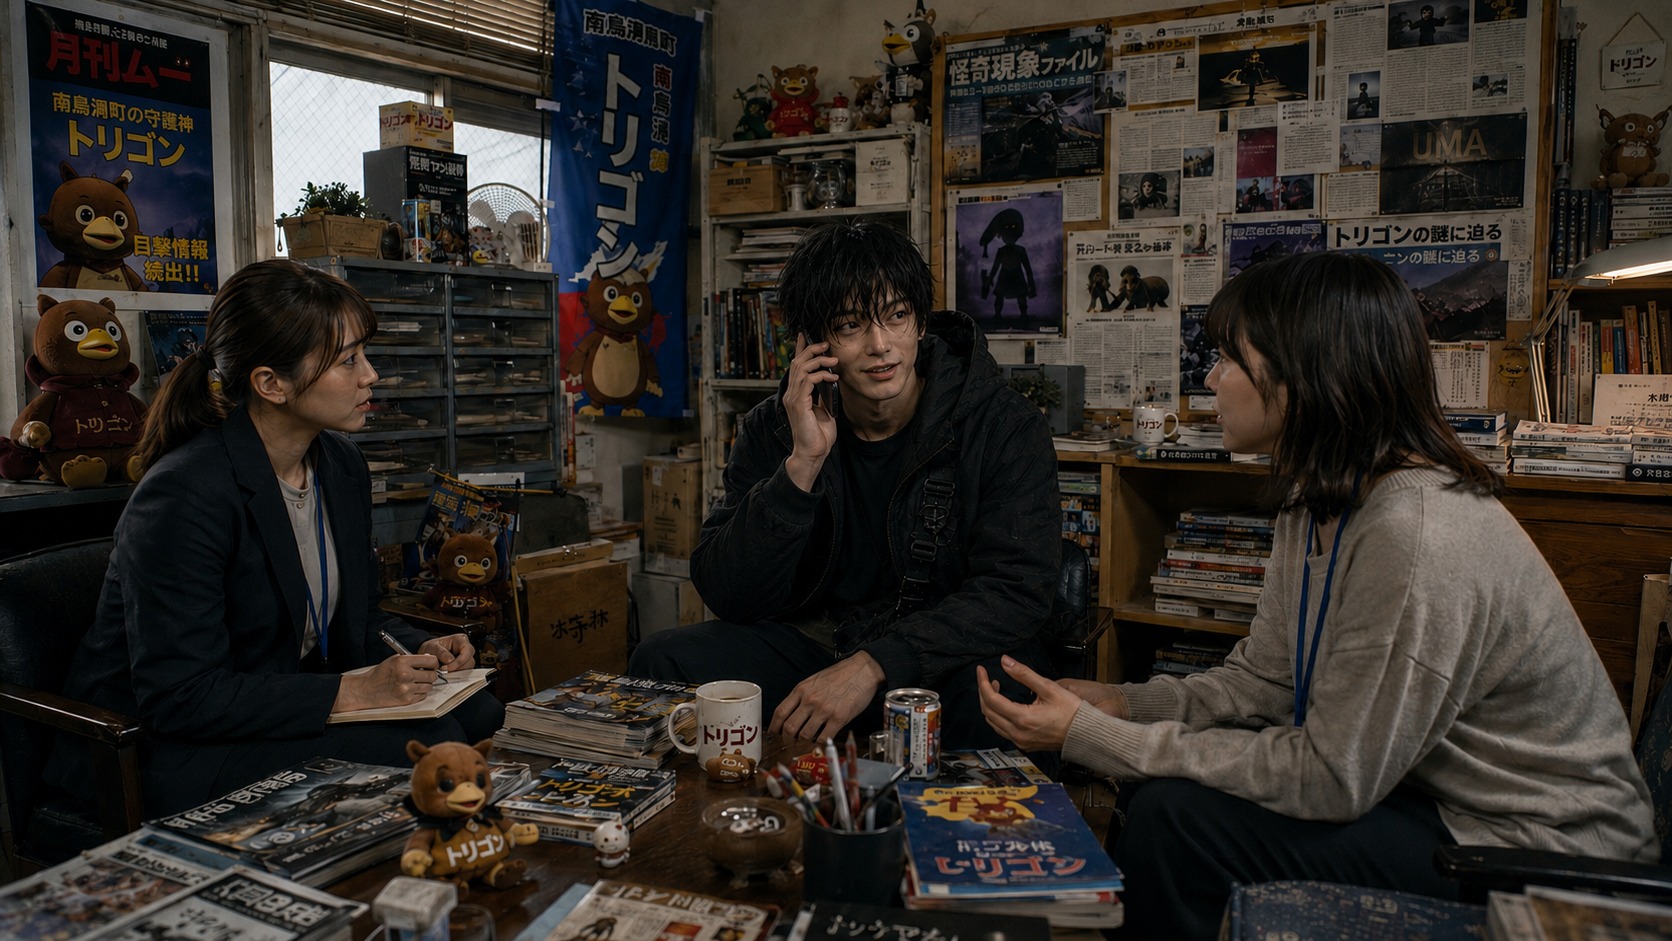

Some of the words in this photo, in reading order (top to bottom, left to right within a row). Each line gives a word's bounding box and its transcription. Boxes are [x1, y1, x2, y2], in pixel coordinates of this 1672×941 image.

[46, 30, 191, 88] 月刊ムー
[949, 48, 1098, 86] 怪奇現象ファイル
[67, 119, 186, 168] トリゴン
[1413, 128, 1488, 160] UMA
[596, 52, 644, 278] トリゴン
[133, 235, 209, 260] 目撃情報
[1336, 223, 1502, 247] トリゴンの謎に迫る
[144, 260, 199, 283] 続出!!
[446, 834, 504, 868] トリゴン
